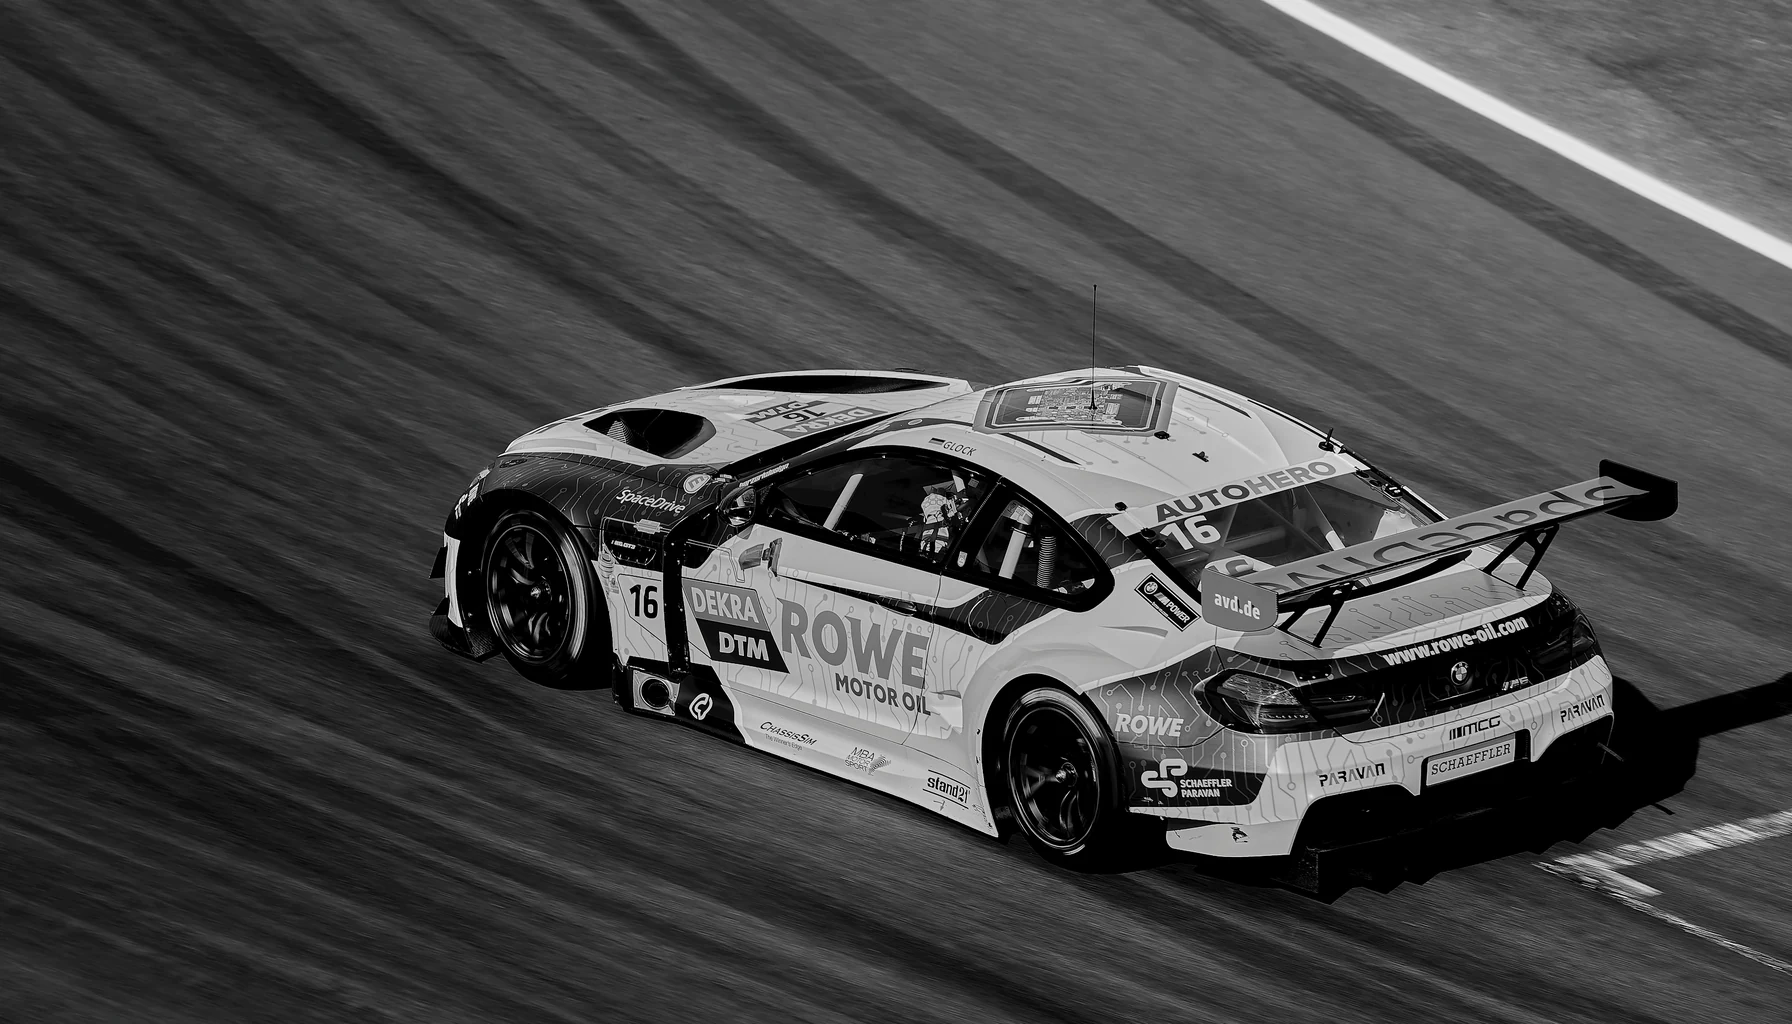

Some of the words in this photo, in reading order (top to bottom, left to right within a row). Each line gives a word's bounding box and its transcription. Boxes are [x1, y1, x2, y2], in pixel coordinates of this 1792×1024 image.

[750, 402, 809, 419] DTM
[782, 409, 873, 432] DEKRA
[943, 441, 977, 456] GLOCK
[616, 490, 686, 513] SpaceDrive
[1156, 461, 1336, 522] AUTOHERO
[1160, 515, 1221, 550] 16
[629, 584, 659, 618] 16
[692, 587, 760, 623] DEKRA
[1166, 602, 1190, 623] POWER
[1214, 593, 1261, 620] avd.de
[719, 631, 770, 661] DTM
[777, 598, 930, 689] ROWE
[1382, 616, 1529, 666] www.rowe-oil.com
[835, 673, 898, 707] MOTOR
[902, 694, 931, 716] OIL
[1560, 694, 1606, 723] PARAVAN
[1115, 713, 1184, 737] ROWE
[844, 759, 869, 773] SPORT
[850, 746, 875, 761] MBA
[1431, 743, 1511, 775] SCHAEFFLER
[1180, 778, 1233, 788] SCHAEFFLER
[1318, 762, 1386, 787] PARAVAN
[927, 777, 968, 803] stand21
[1181, 788, 1221, 798] PARAVAN
